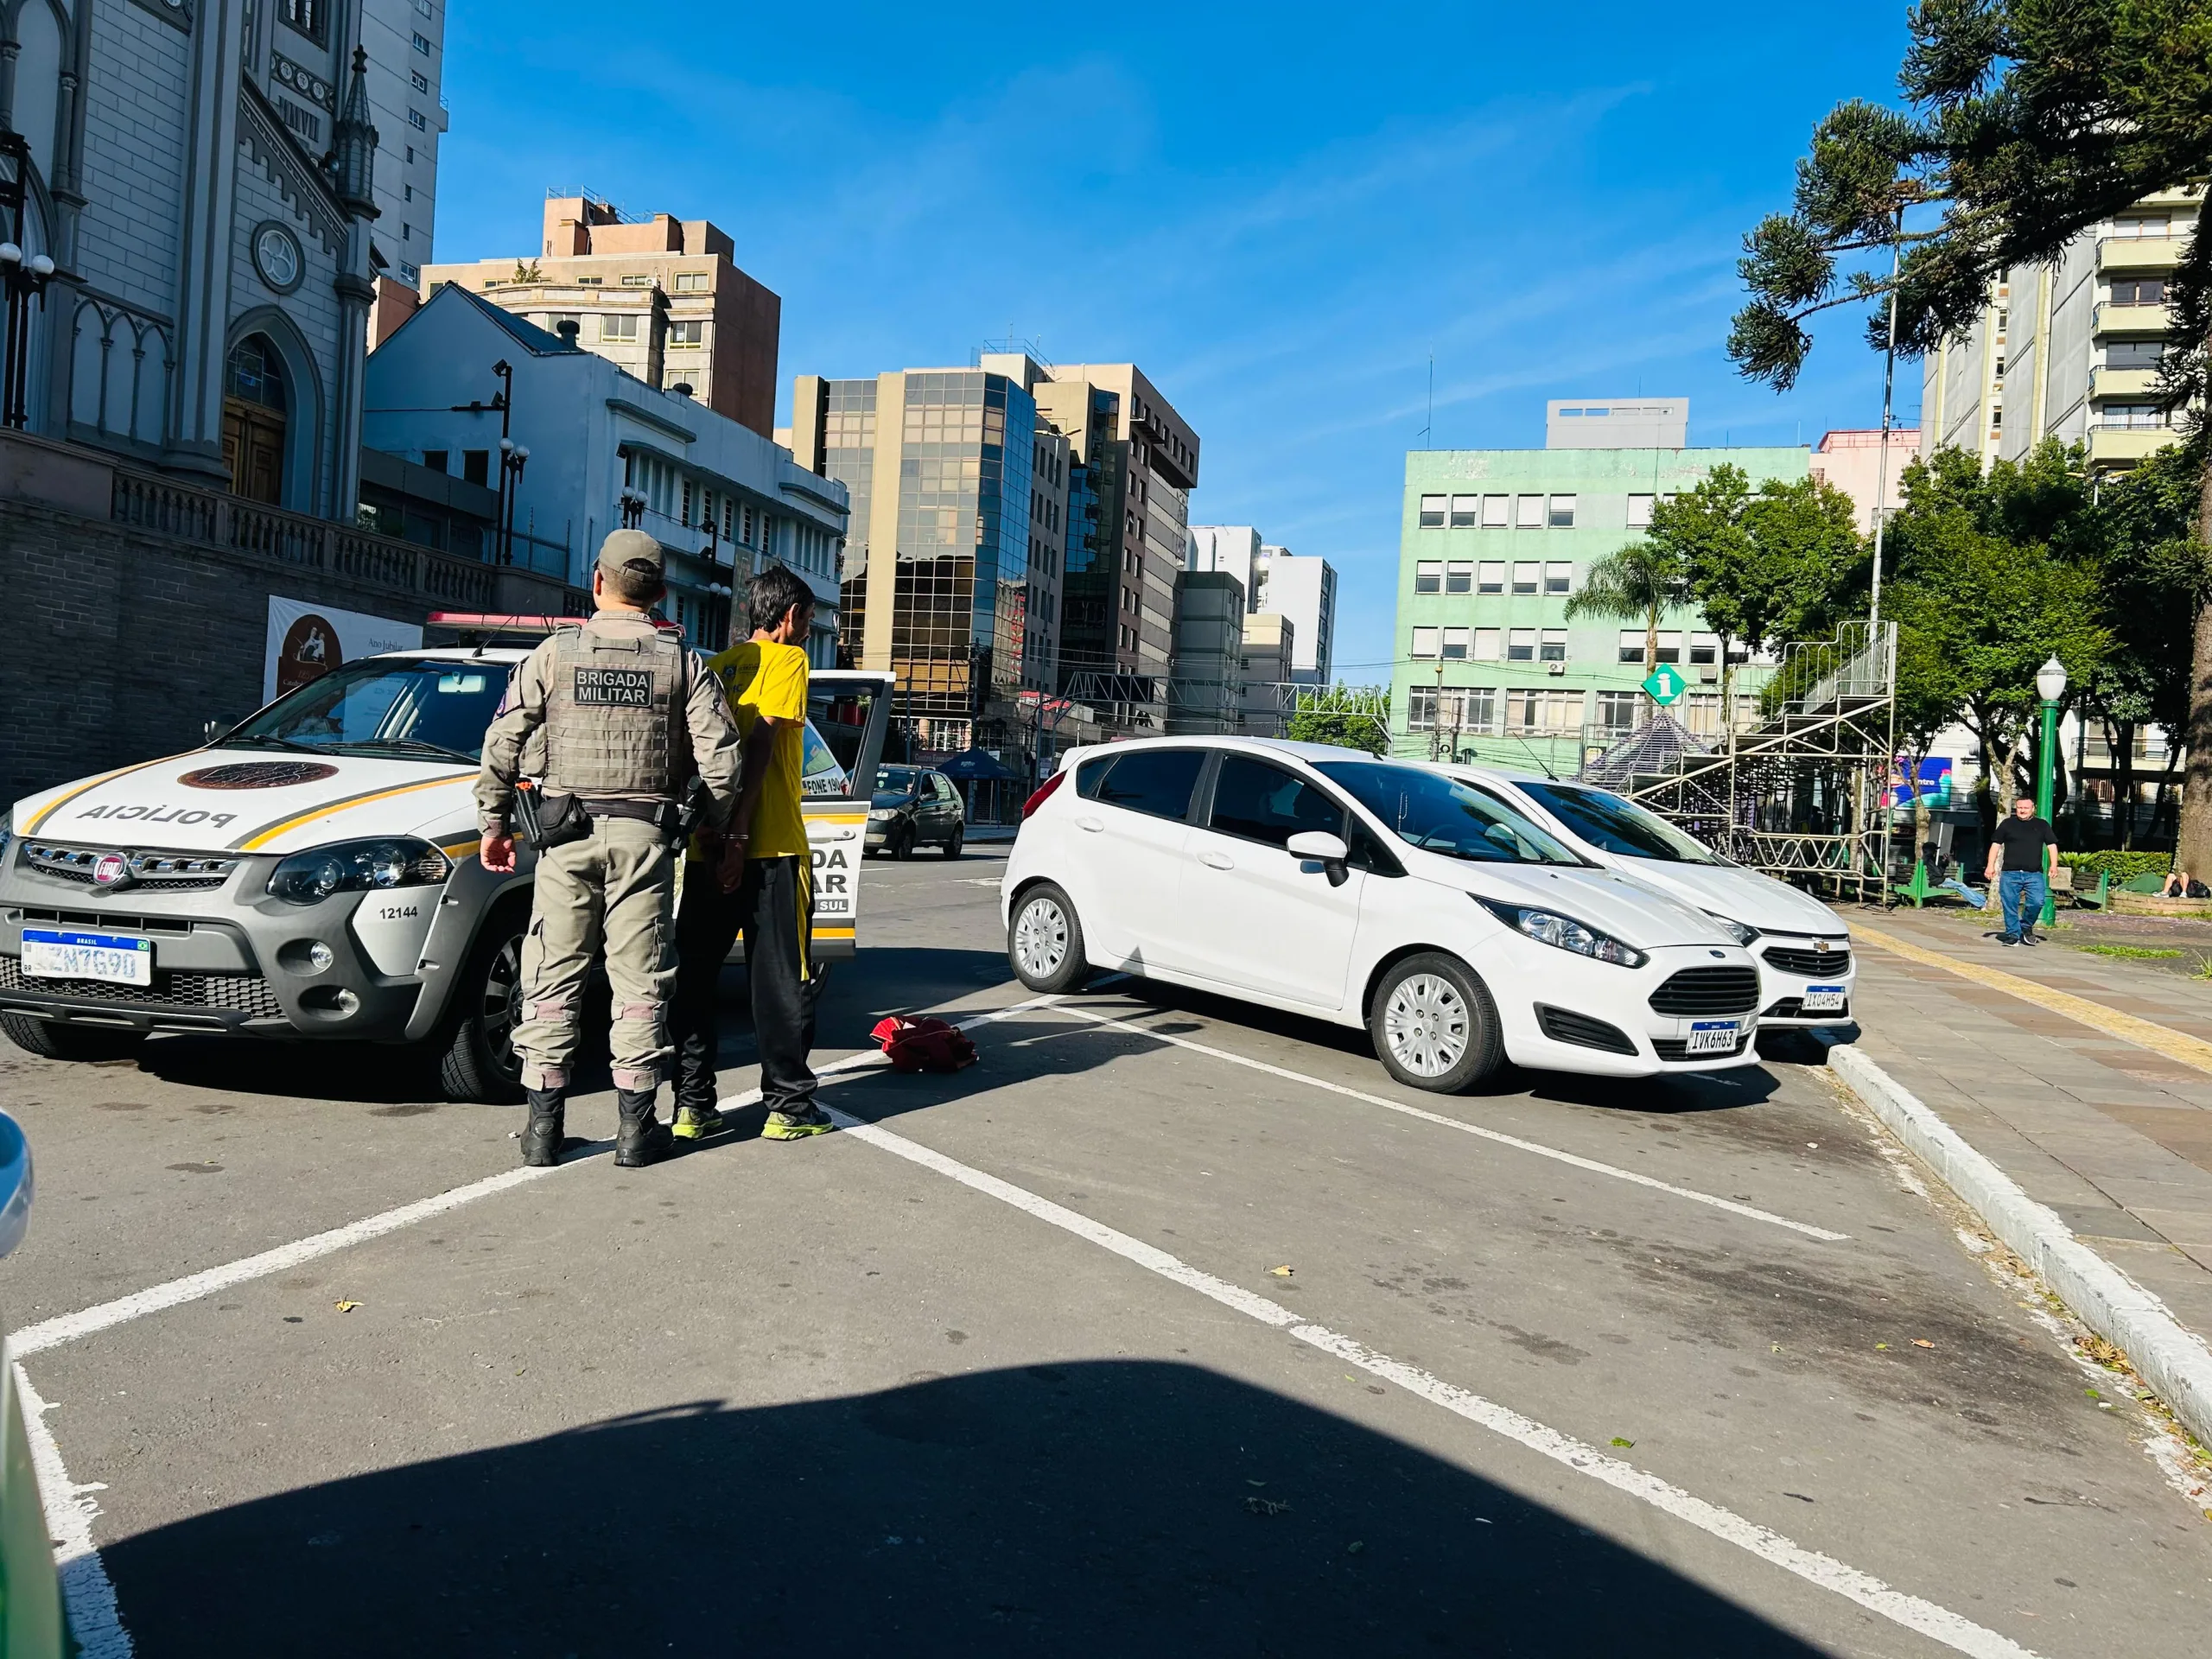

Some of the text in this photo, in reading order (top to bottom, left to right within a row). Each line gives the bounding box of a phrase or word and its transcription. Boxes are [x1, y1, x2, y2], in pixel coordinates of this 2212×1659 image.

[369, 638, 382, 648] Ano
[577, 671, 648, 688] BRIGADA
[579, 687, 645, 702] MILITAR
[806, 777, 842, 795] FONE 190
[99, 861, 119, 876] FIAT
[379, 906, 418, 919] 12144
[819, 900, 847, 911] SUL
[23, 964, 32, 973] BR
[1692, 1030, 1734, 1050] IVK6H63
